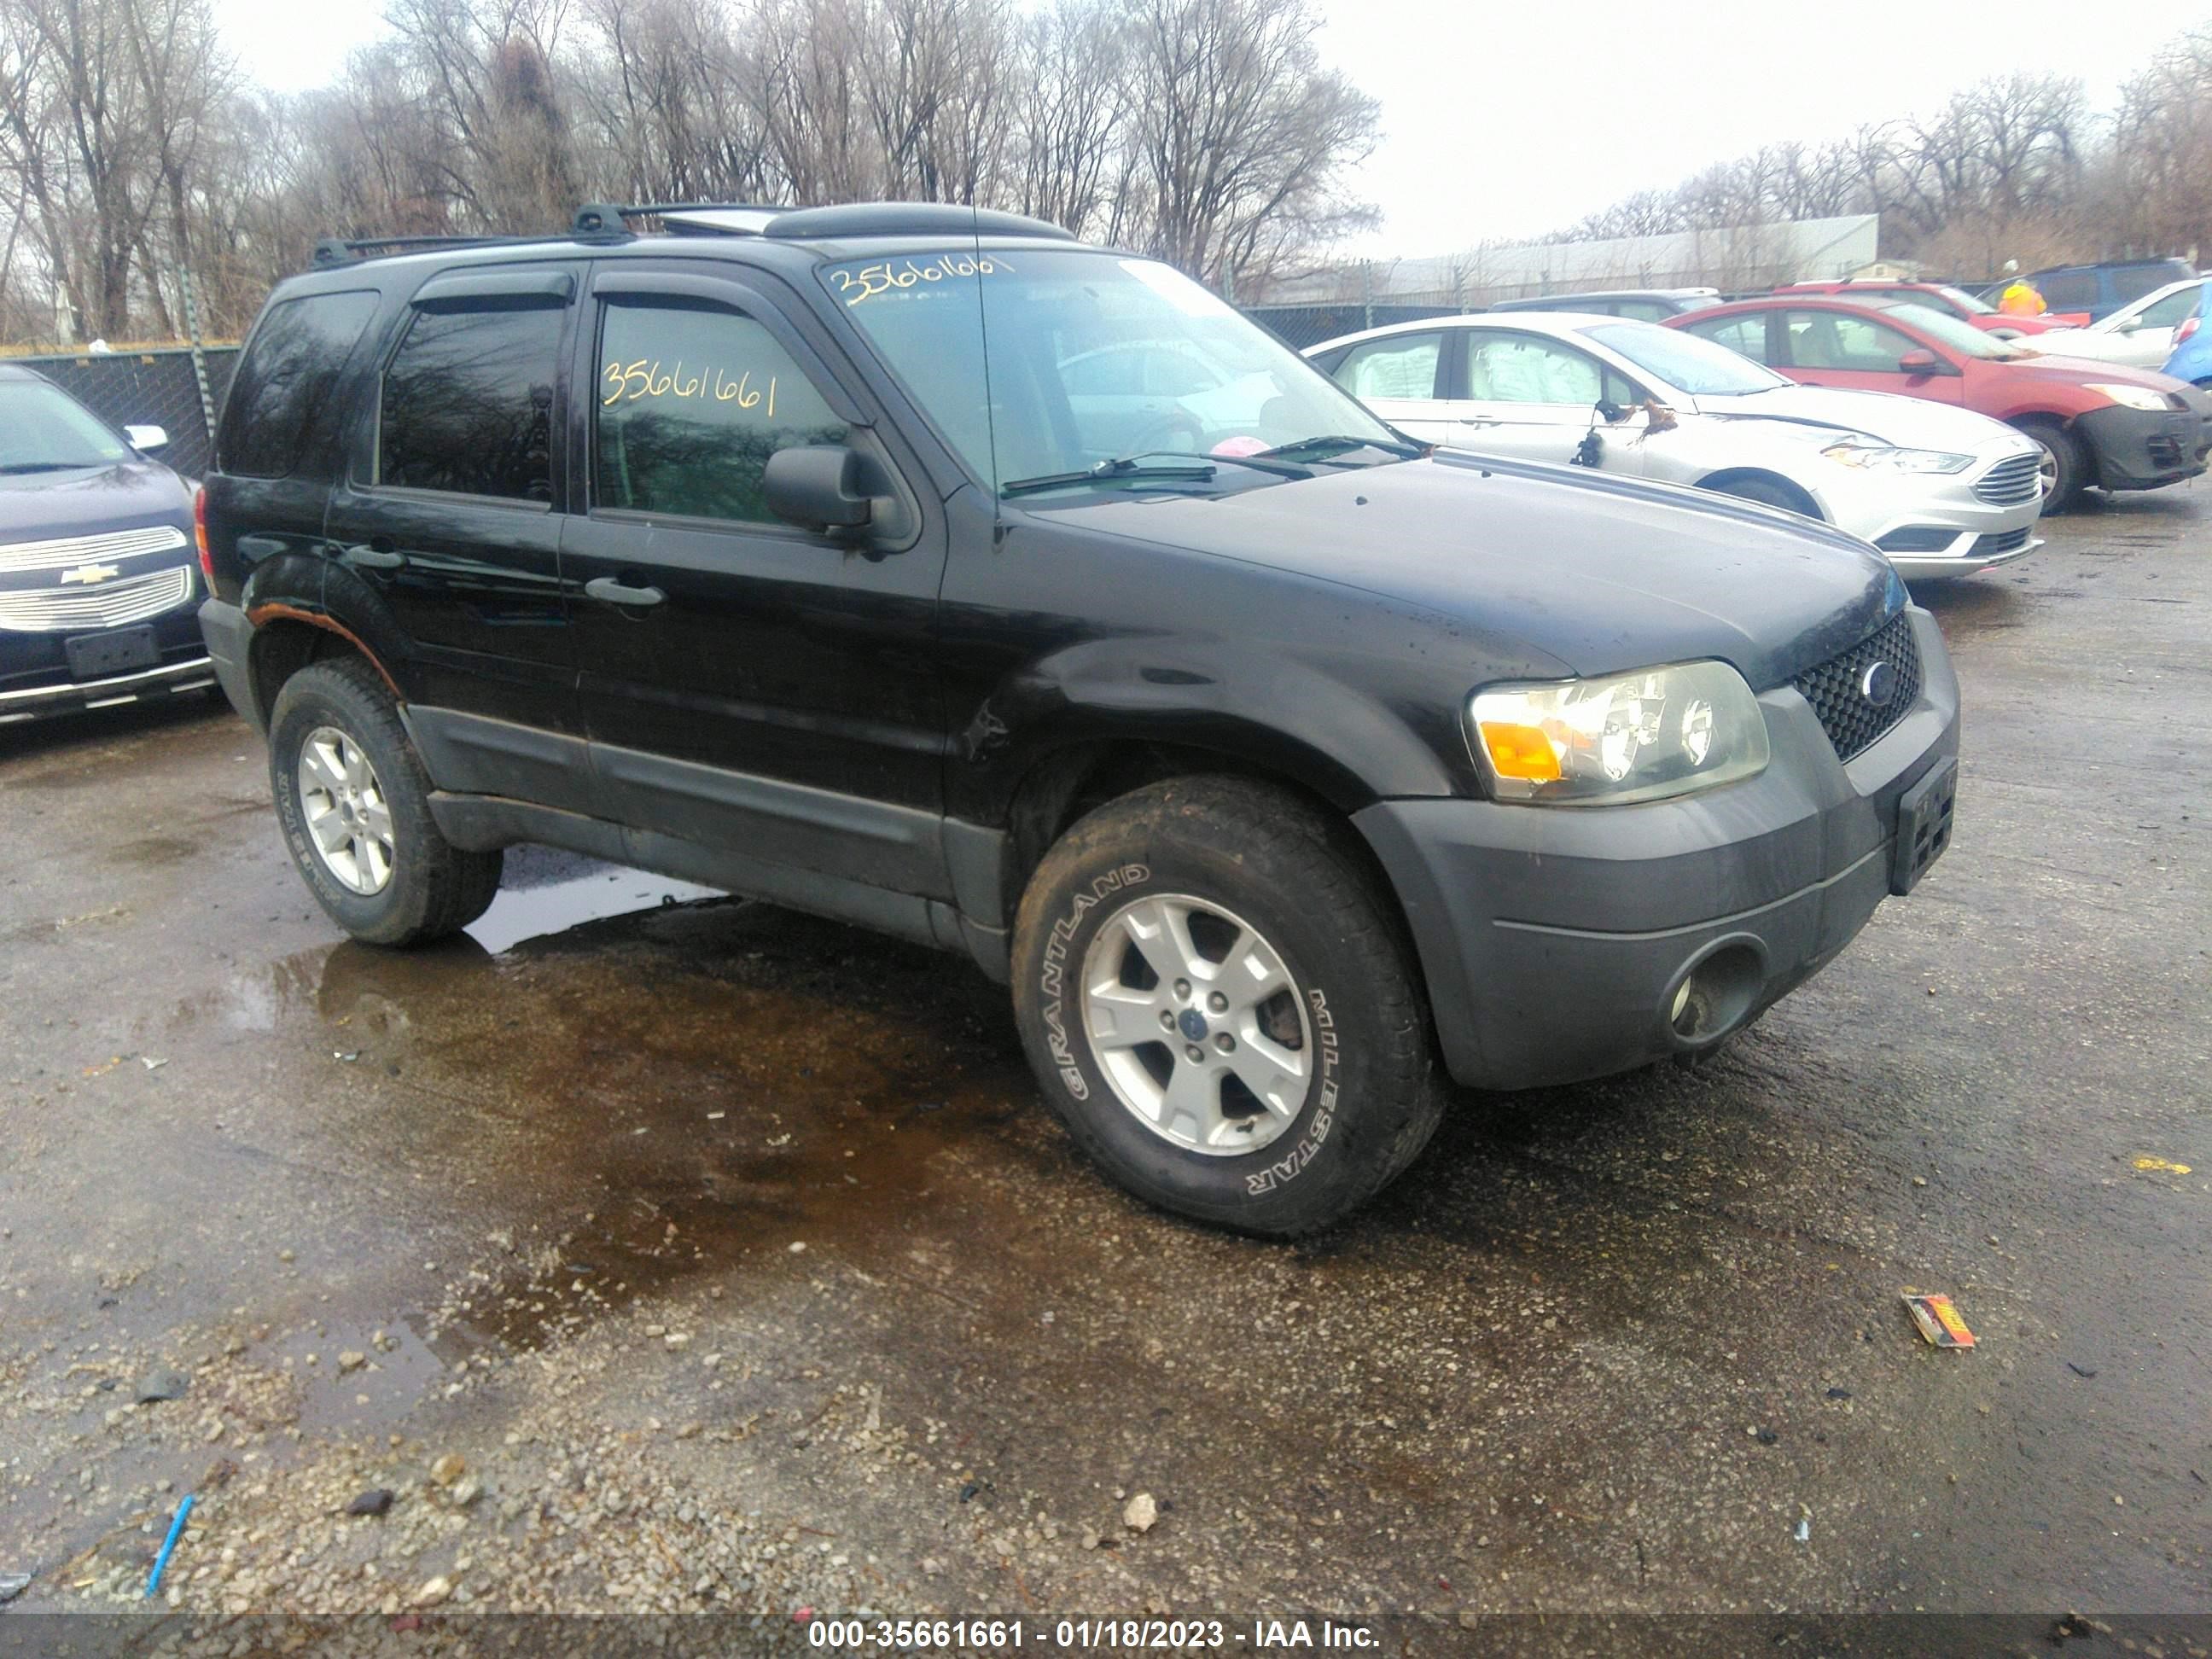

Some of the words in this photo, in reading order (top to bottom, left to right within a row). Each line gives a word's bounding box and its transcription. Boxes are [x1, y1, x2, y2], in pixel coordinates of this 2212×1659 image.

[830, 254, 1016, 308] 35661661
[603, 359, 776, 417] 35661661
[1041, 863, 1151, 1101] GRANTLAND
[1245, 988, 1339, 1196] MILESTAR
